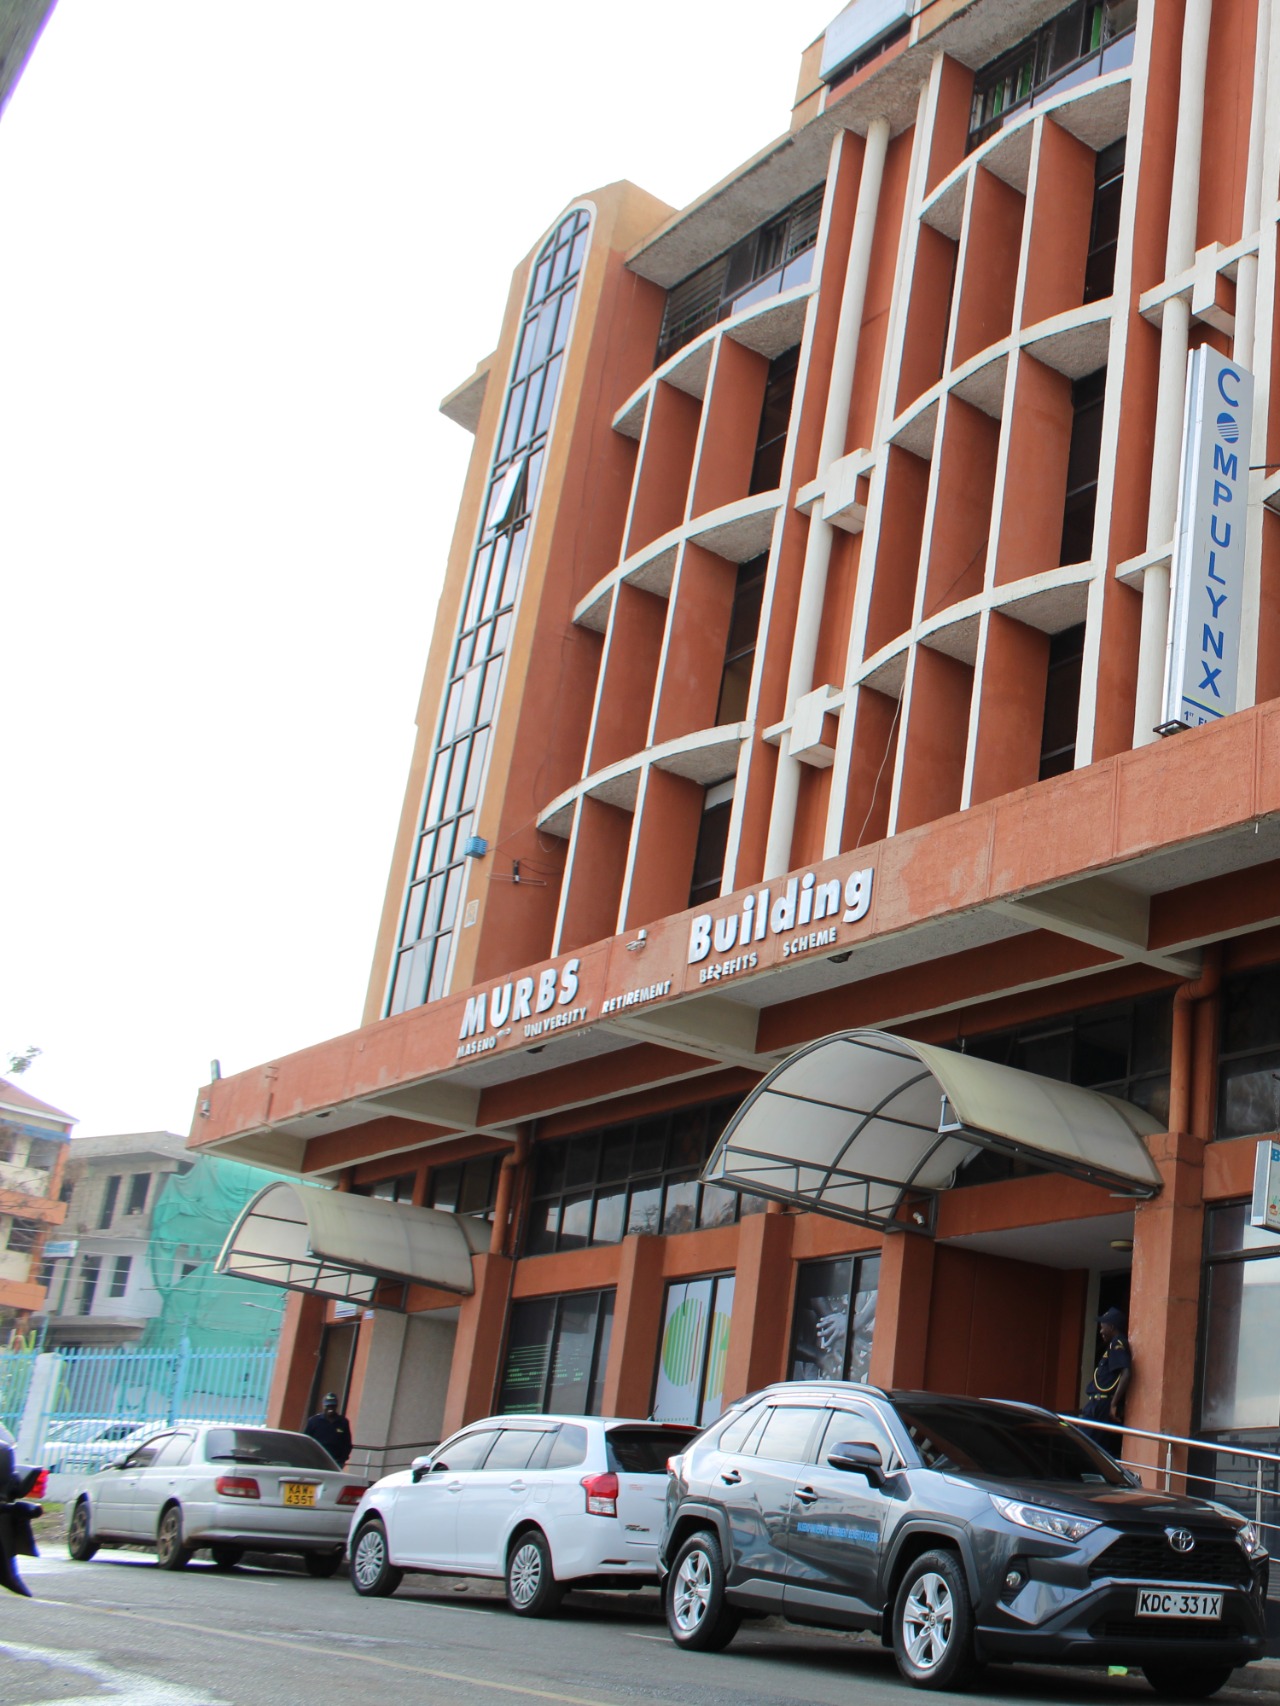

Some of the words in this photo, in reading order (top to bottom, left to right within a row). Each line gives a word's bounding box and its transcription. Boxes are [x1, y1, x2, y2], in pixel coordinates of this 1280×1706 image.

[1198, 367, 1241, 699] COMPULYNX
[456, 1035, 497, 1060] MASENO
[524, 1007, 587, 1038] UNIVERSITY
[601, 980, 672, 1014] RETIREMENT
[783, 927, 837, 958] SCHEME
[458, 957, 581, 1040] MURBS
[688, 867, 875, 965] Building
[286, 1494, 314, 1505] 435T
